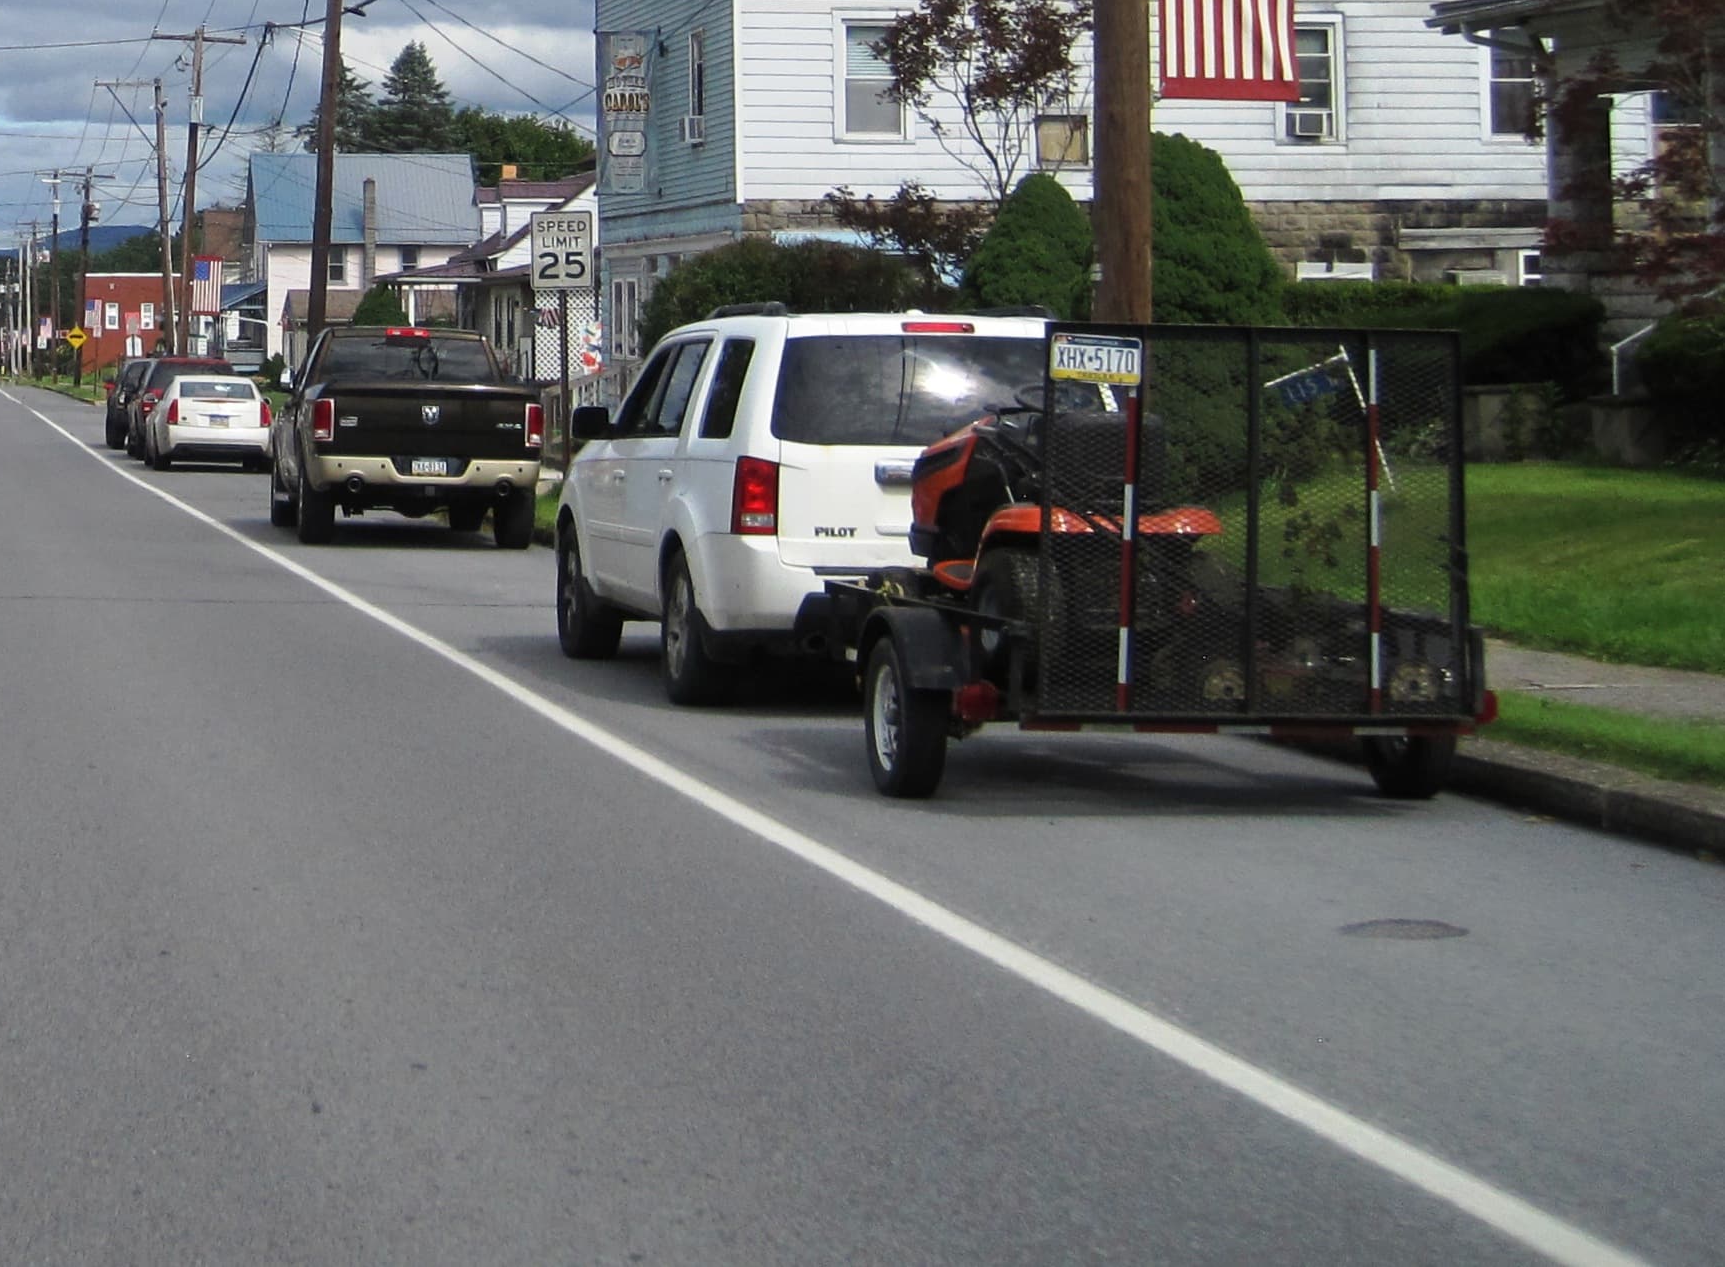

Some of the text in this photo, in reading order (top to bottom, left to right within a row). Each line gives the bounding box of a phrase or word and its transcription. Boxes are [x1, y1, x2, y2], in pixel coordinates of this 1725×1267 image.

[537, 220, 587, 233] SPEED
[542, 236, 581, 248] LIMIT
[538, 251, 586, 280] 25
[814, 526, 858, 538] PILOT
